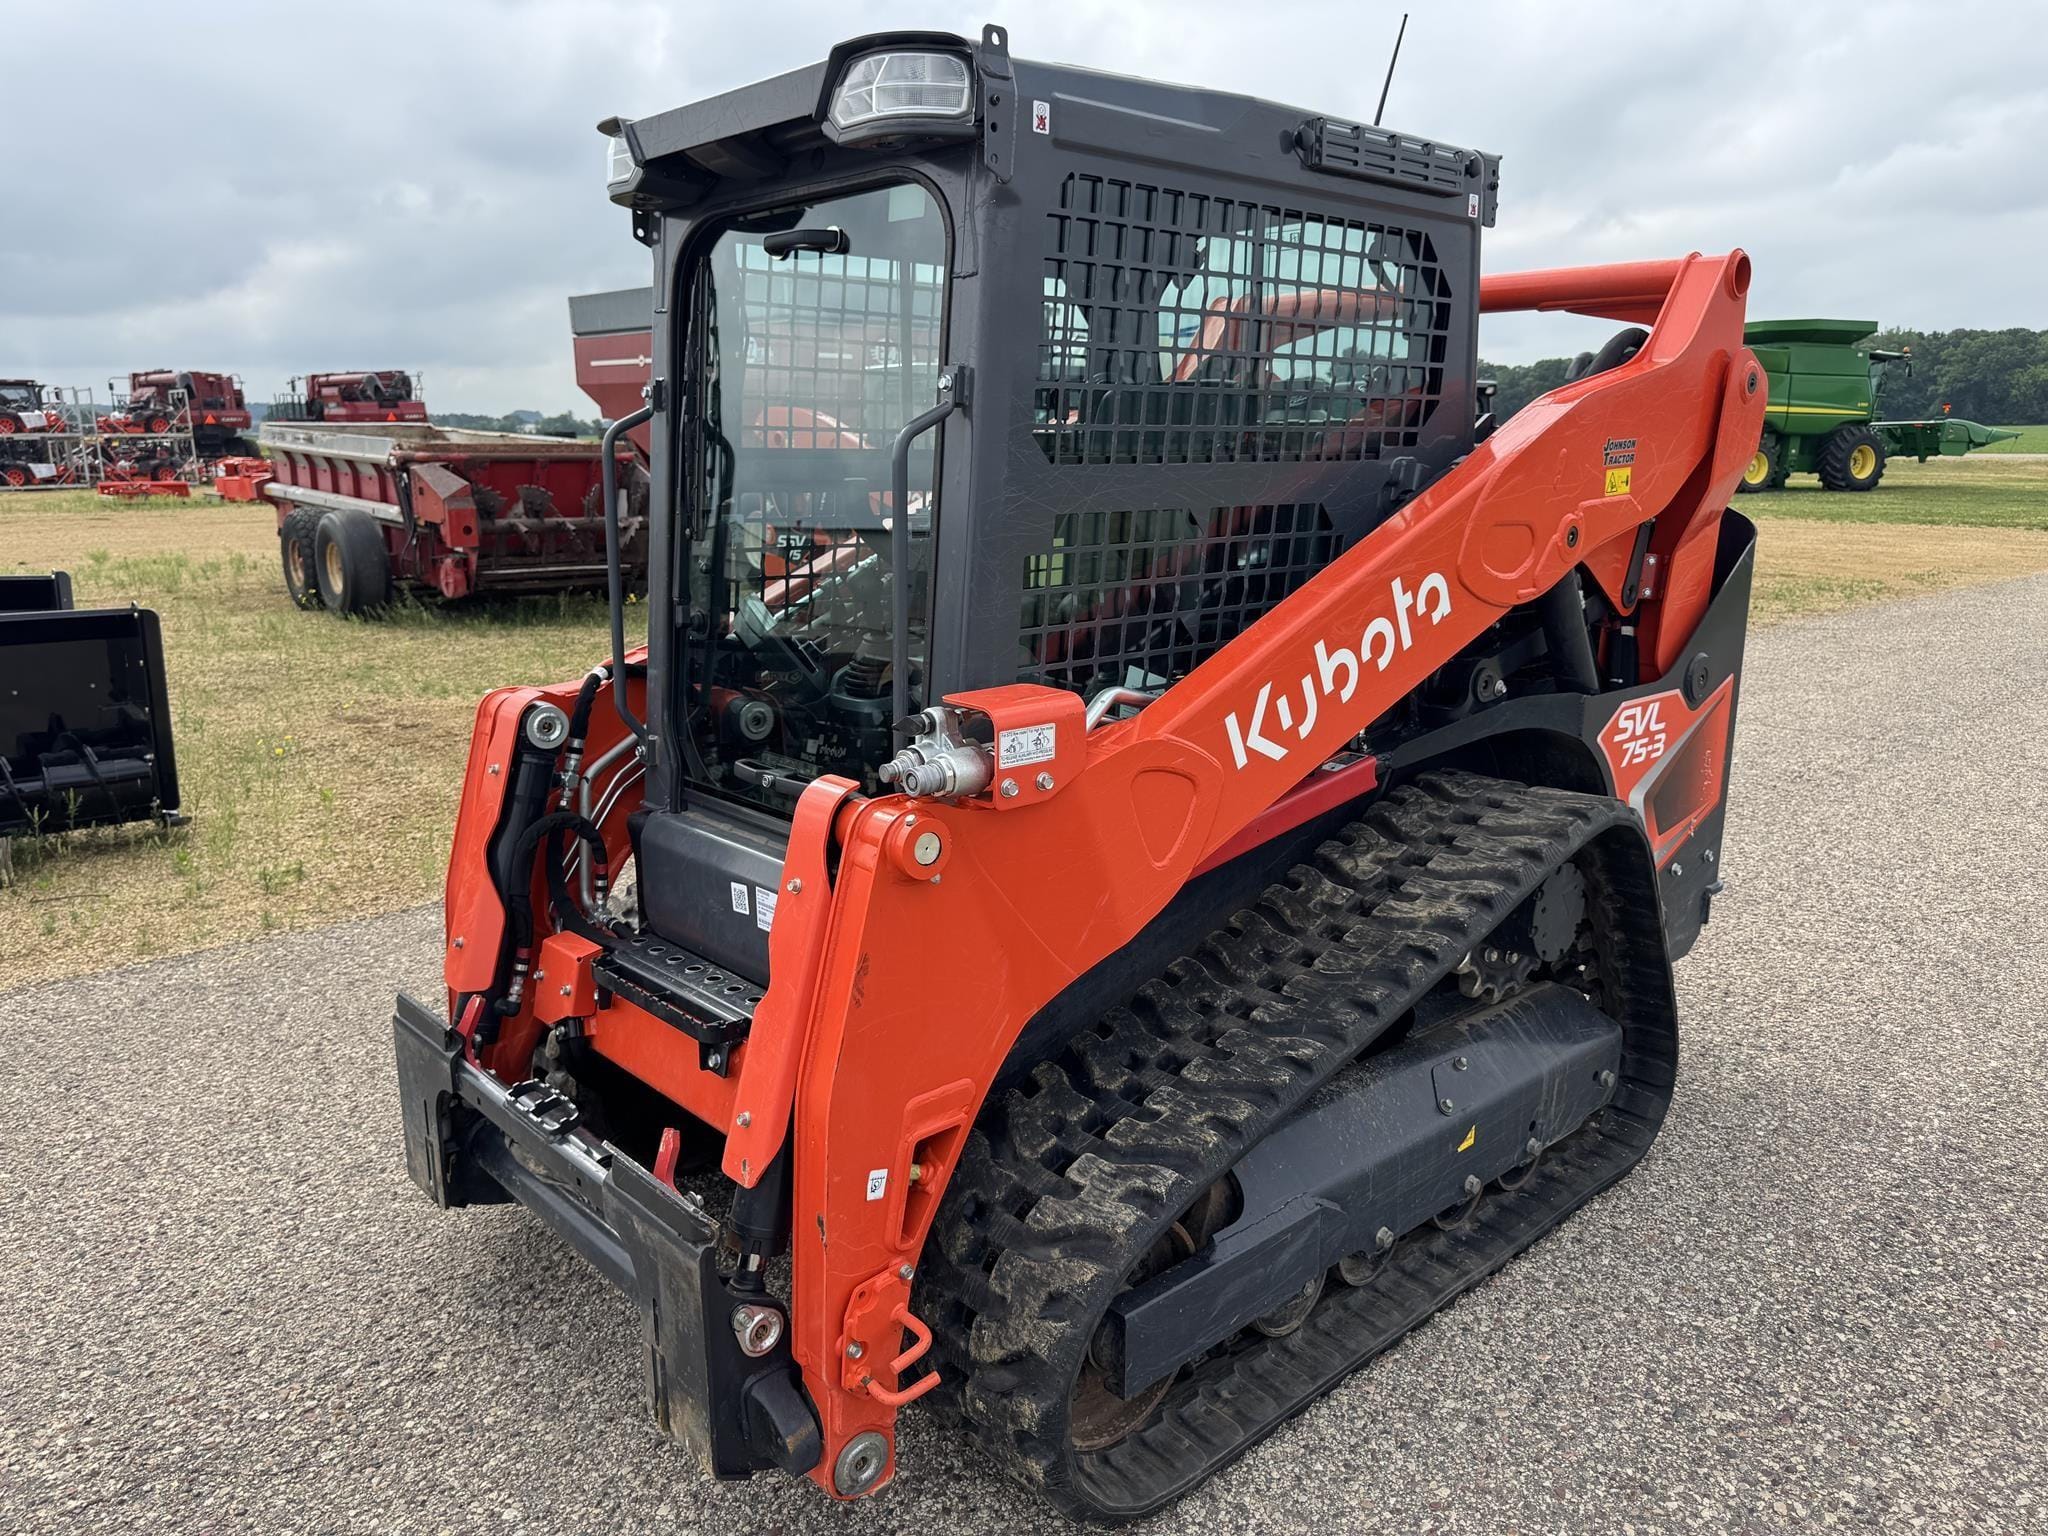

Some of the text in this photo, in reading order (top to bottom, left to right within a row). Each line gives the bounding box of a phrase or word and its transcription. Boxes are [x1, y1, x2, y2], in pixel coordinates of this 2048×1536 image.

[1603, 437, 1637, 452] JOHNSON
[1603, 452, 1635, 466] TRACTOR
[1224, 572, 1452, 770] Kubota
[1613, 701, 1666, 742] SVL
[1620, 732, 1666, 768] 75-3
